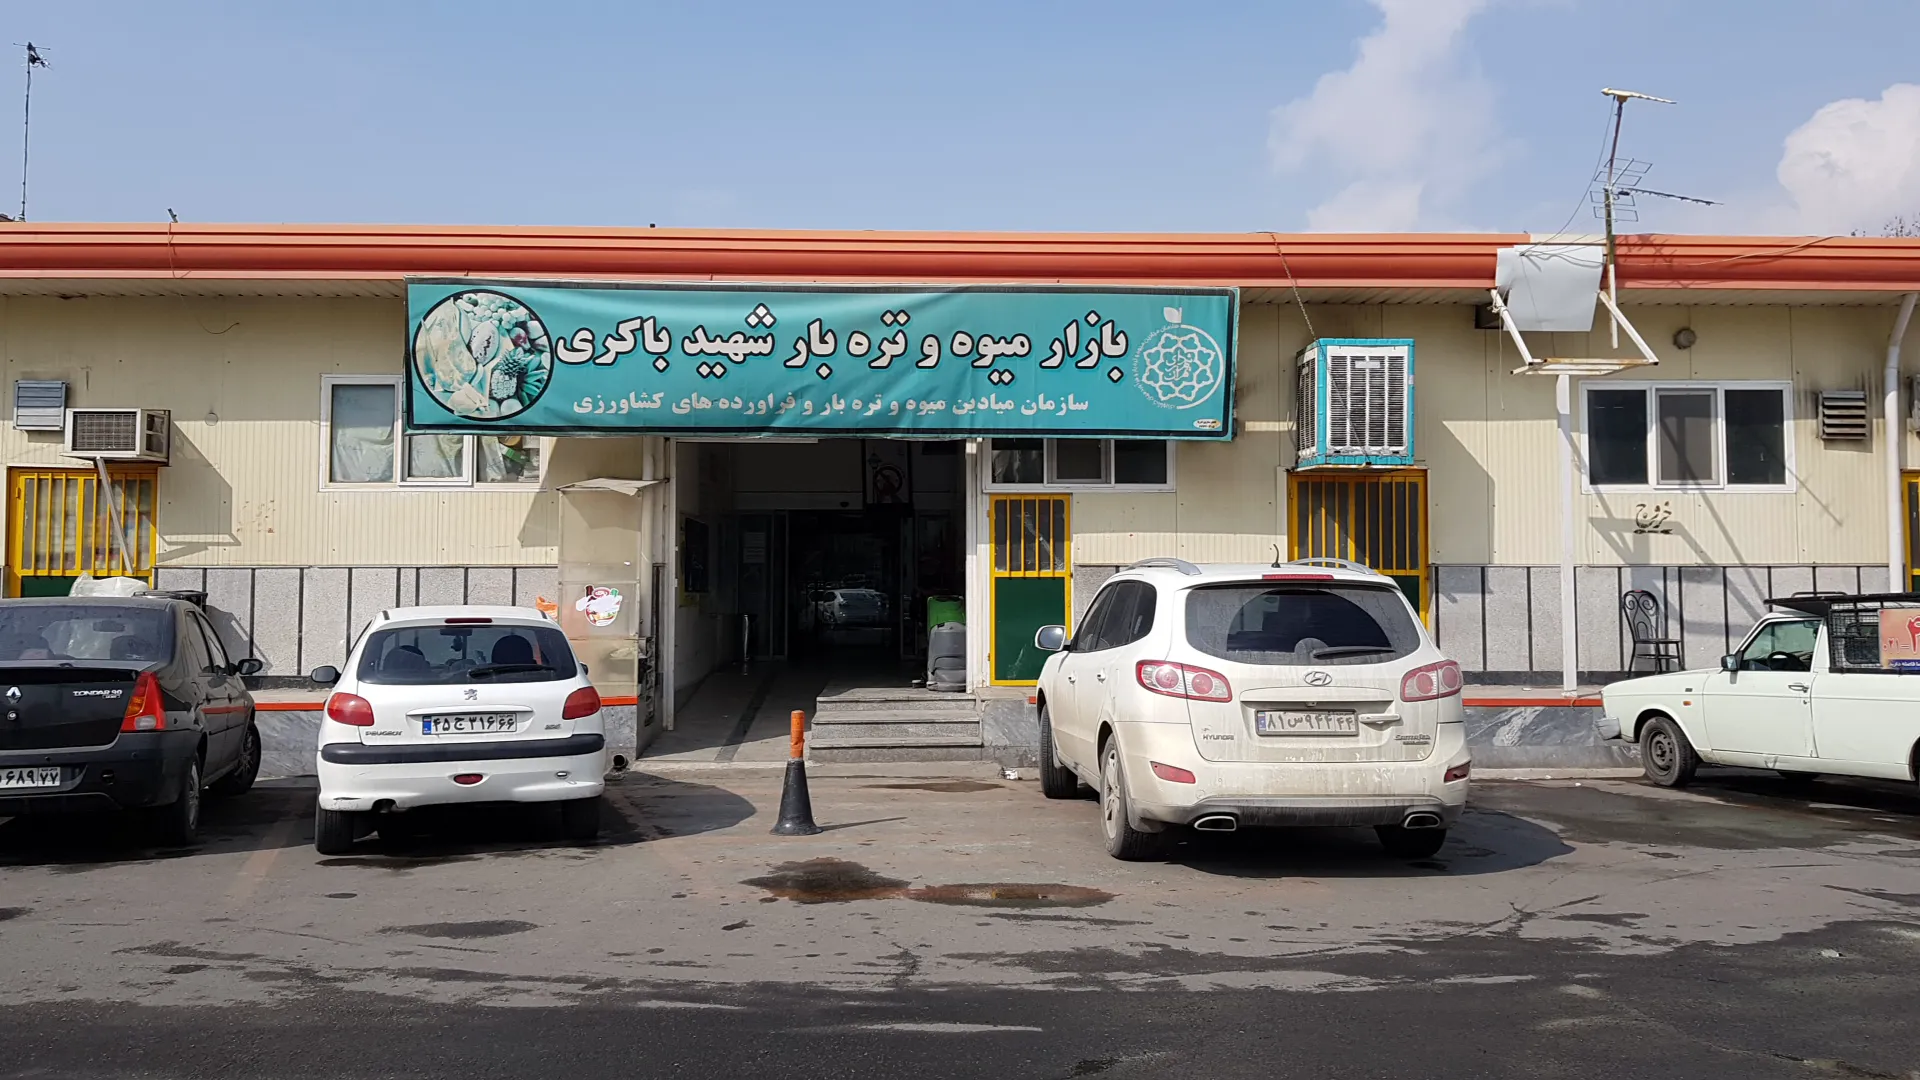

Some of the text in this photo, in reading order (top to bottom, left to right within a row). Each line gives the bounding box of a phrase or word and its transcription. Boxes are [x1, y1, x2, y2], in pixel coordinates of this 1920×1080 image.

[556, 303, 1129, 385] بازار میوه و تره بار شهید باکری
[573, 391, 664, 415] کشاورزی
[802, 397, 814, 414] و
[820, 393, 846, 415] بار
[851, 393, 882, 414] تره
[891, 399, 899, 414] و
[905, 395, 946, 416] میوه
[952, 393, 1015, 416] میادین
[1020, 394, 1089, 416] سازمان
[1636, 501, 1672, 529] خروج
[0, 770, 36, 786] ۶۸۹
